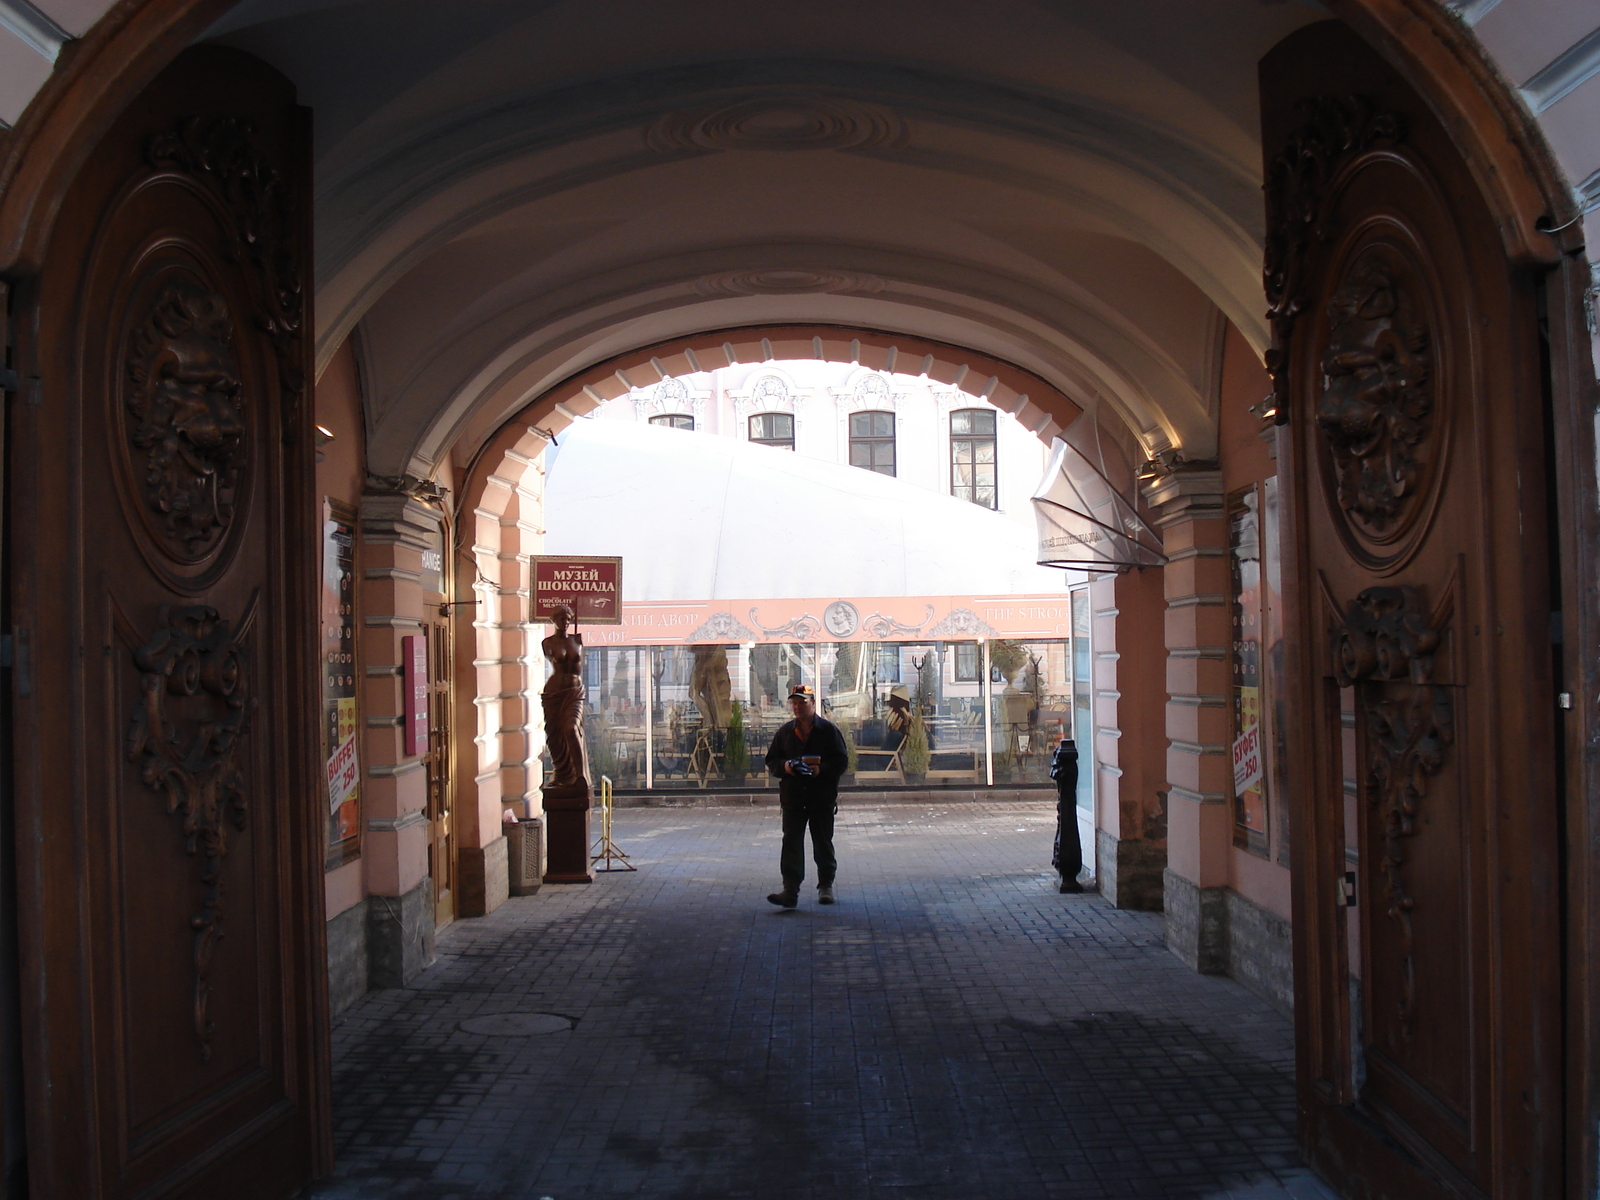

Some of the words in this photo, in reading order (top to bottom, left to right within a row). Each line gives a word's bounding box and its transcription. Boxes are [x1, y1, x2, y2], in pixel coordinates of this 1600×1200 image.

[553, 569, 599, 581] МУЗЕЙ
[537, 581, 615, 593] ШОКОЛАДА
[622, 612, 653, 626] КИЙ
[657, 613, 699, 627] ДВОР
[983, 607, 1015, 620] THE
[1055, 623, 1069, 635] C
[586, 630, 629, 643] КАФЕ
[1233, 727, 1258, 765] БУФЕТ
[328, 736, 355, 782] BUFFET
[1245, 755, 1257, 780] 250
[342, 762, 355, 791] 250
